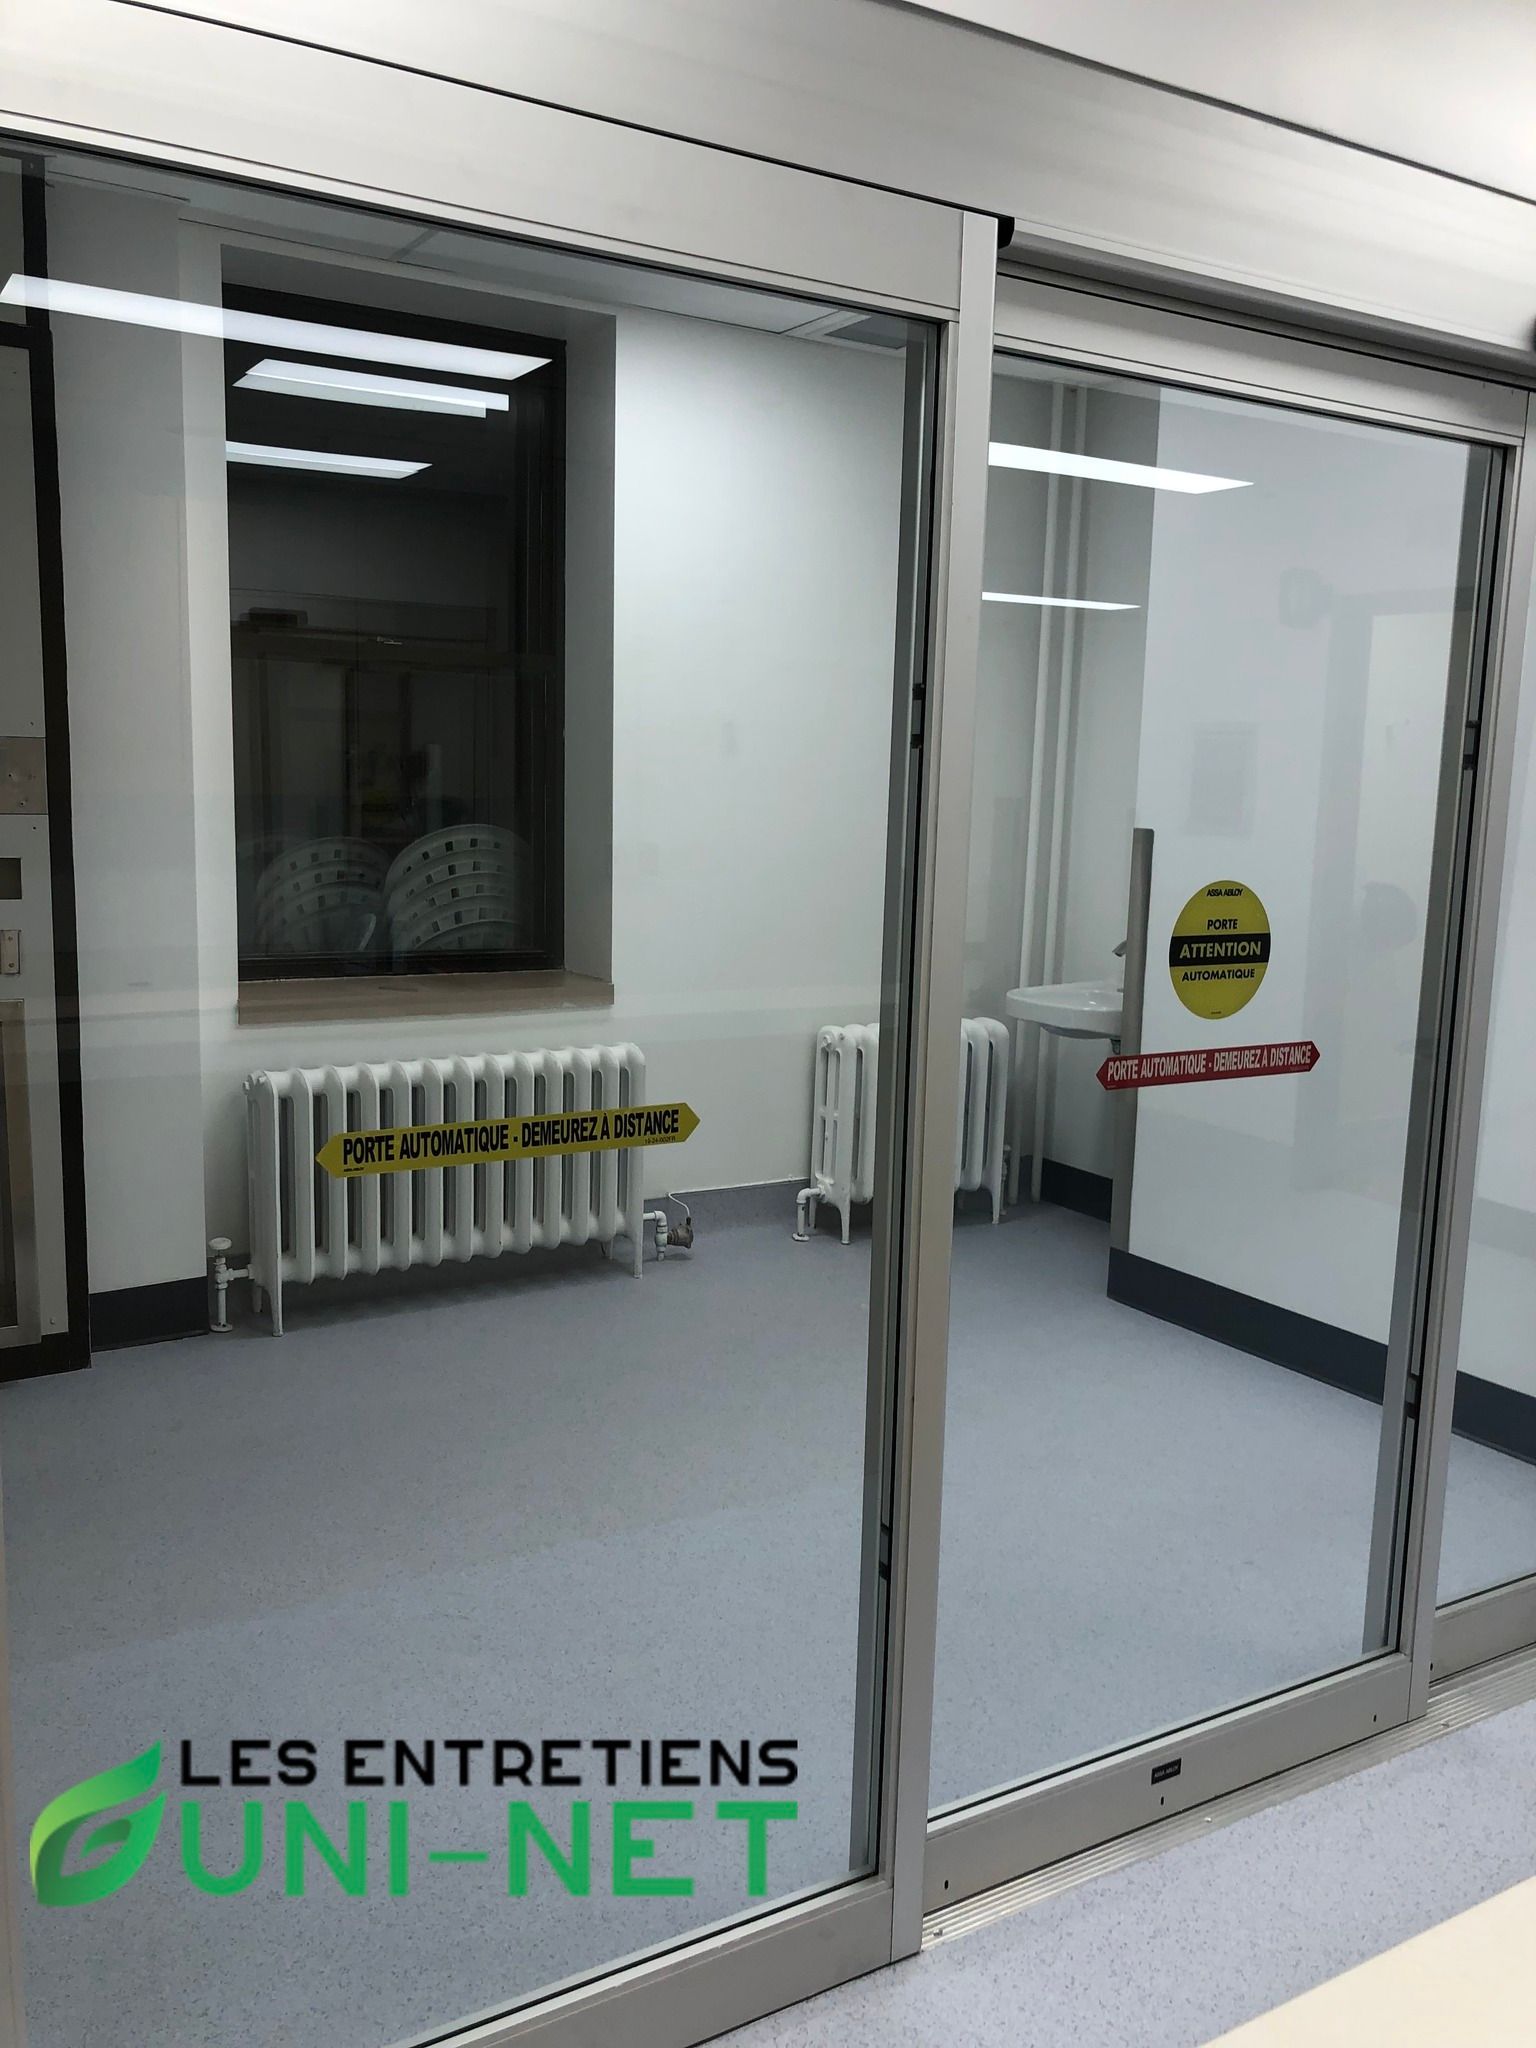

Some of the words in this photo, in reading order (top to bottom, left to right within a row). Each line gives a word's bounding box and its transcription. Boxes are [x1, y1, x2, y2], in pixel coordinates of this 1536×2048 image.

[1206, 888, 1223, 897] ASSA
[1223, 888, 1244, 896] ABLOY
[1207, 918, 1239, 931] PORTE
[1179, 941, 1262, 959] ATTENTION
[1182, 968, 1256, 982] AUTOMATIQUE
[1107, 1059, 1139, 1082] PORTE
[1140, 1053, 1207, 1079] AUTOMATIQUE
[1213, 1048, 1261, 1072] DEMEUREZ
[1261, 1046, 1268, 1070] À
[1269, 1044, 1312, 1067] DISTANCE
[343, 1134, 396, 1166] PORTE
[399, 1124, 510, 1161] AUTOMATIQUE
[521, 1116, 599, 1149] DEMEUREZ
[599, 1112, 611, 1141] À
[613, 1109, 680, 1140] DISTANCE
